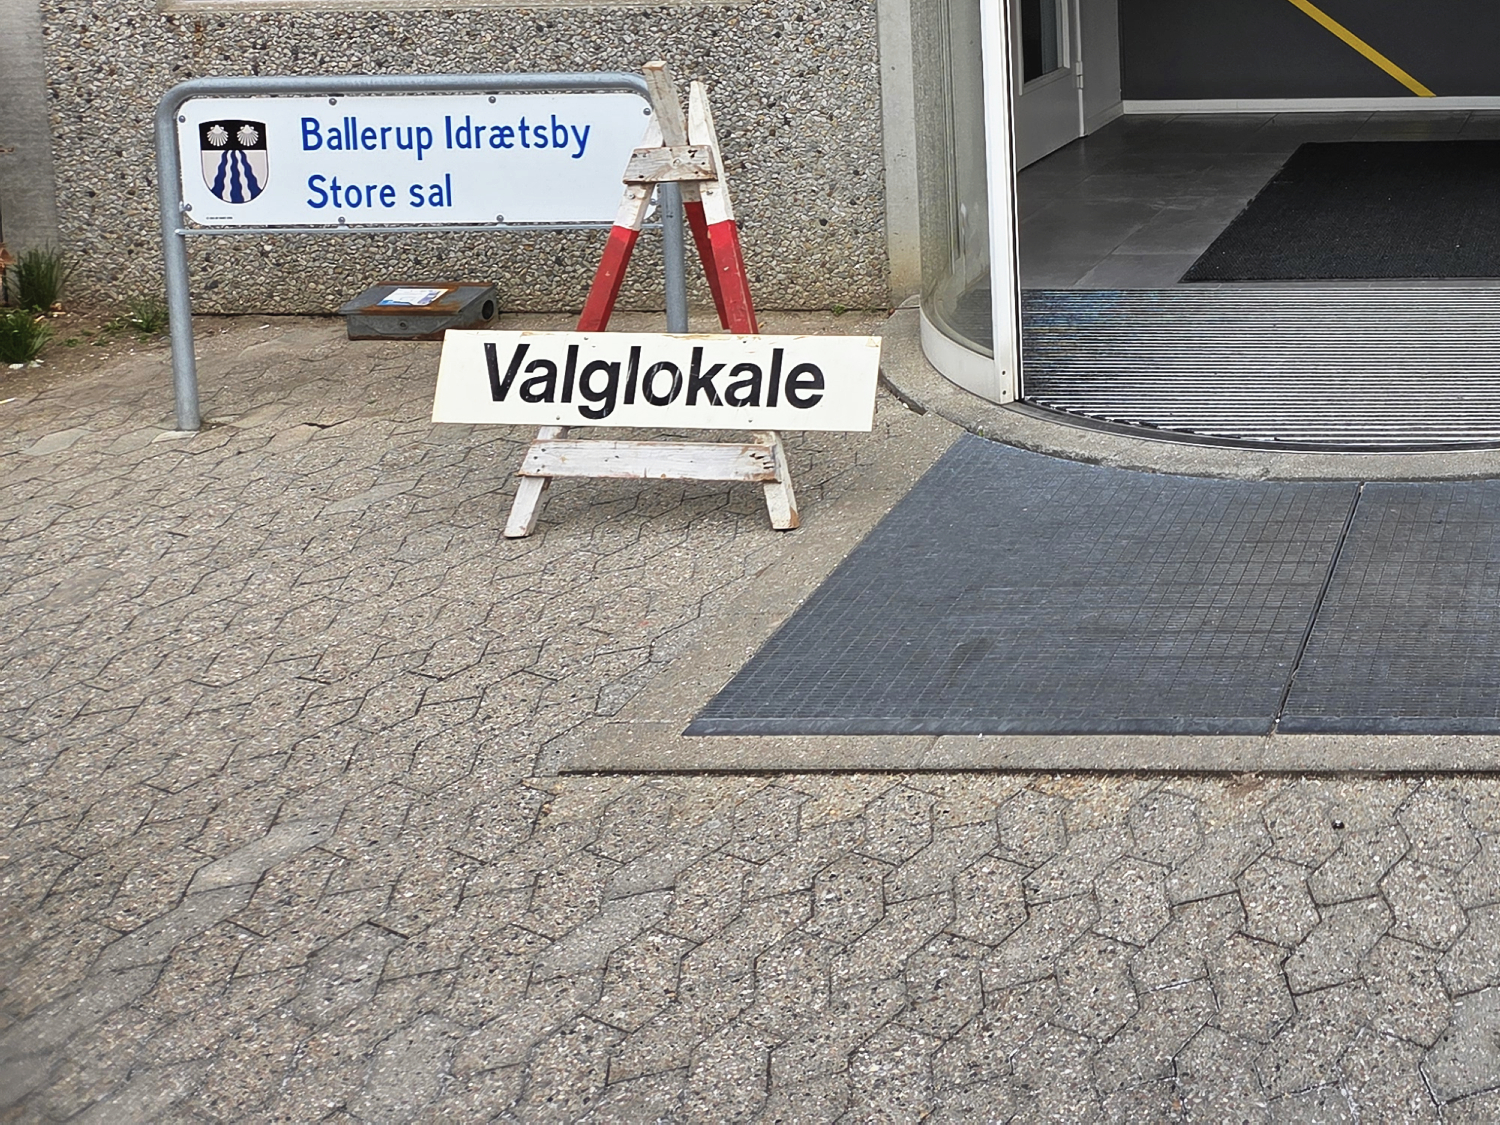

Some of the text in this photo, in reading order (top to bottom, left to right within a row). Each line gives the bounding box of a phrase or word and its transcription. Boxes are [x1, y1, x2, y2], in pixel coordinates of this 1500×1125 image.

[301, 114, 591, 161] Ballerup Idrætsby
[306, 173, 453, 208] Store sal
[484, 342, 825, 420] Valglokale
